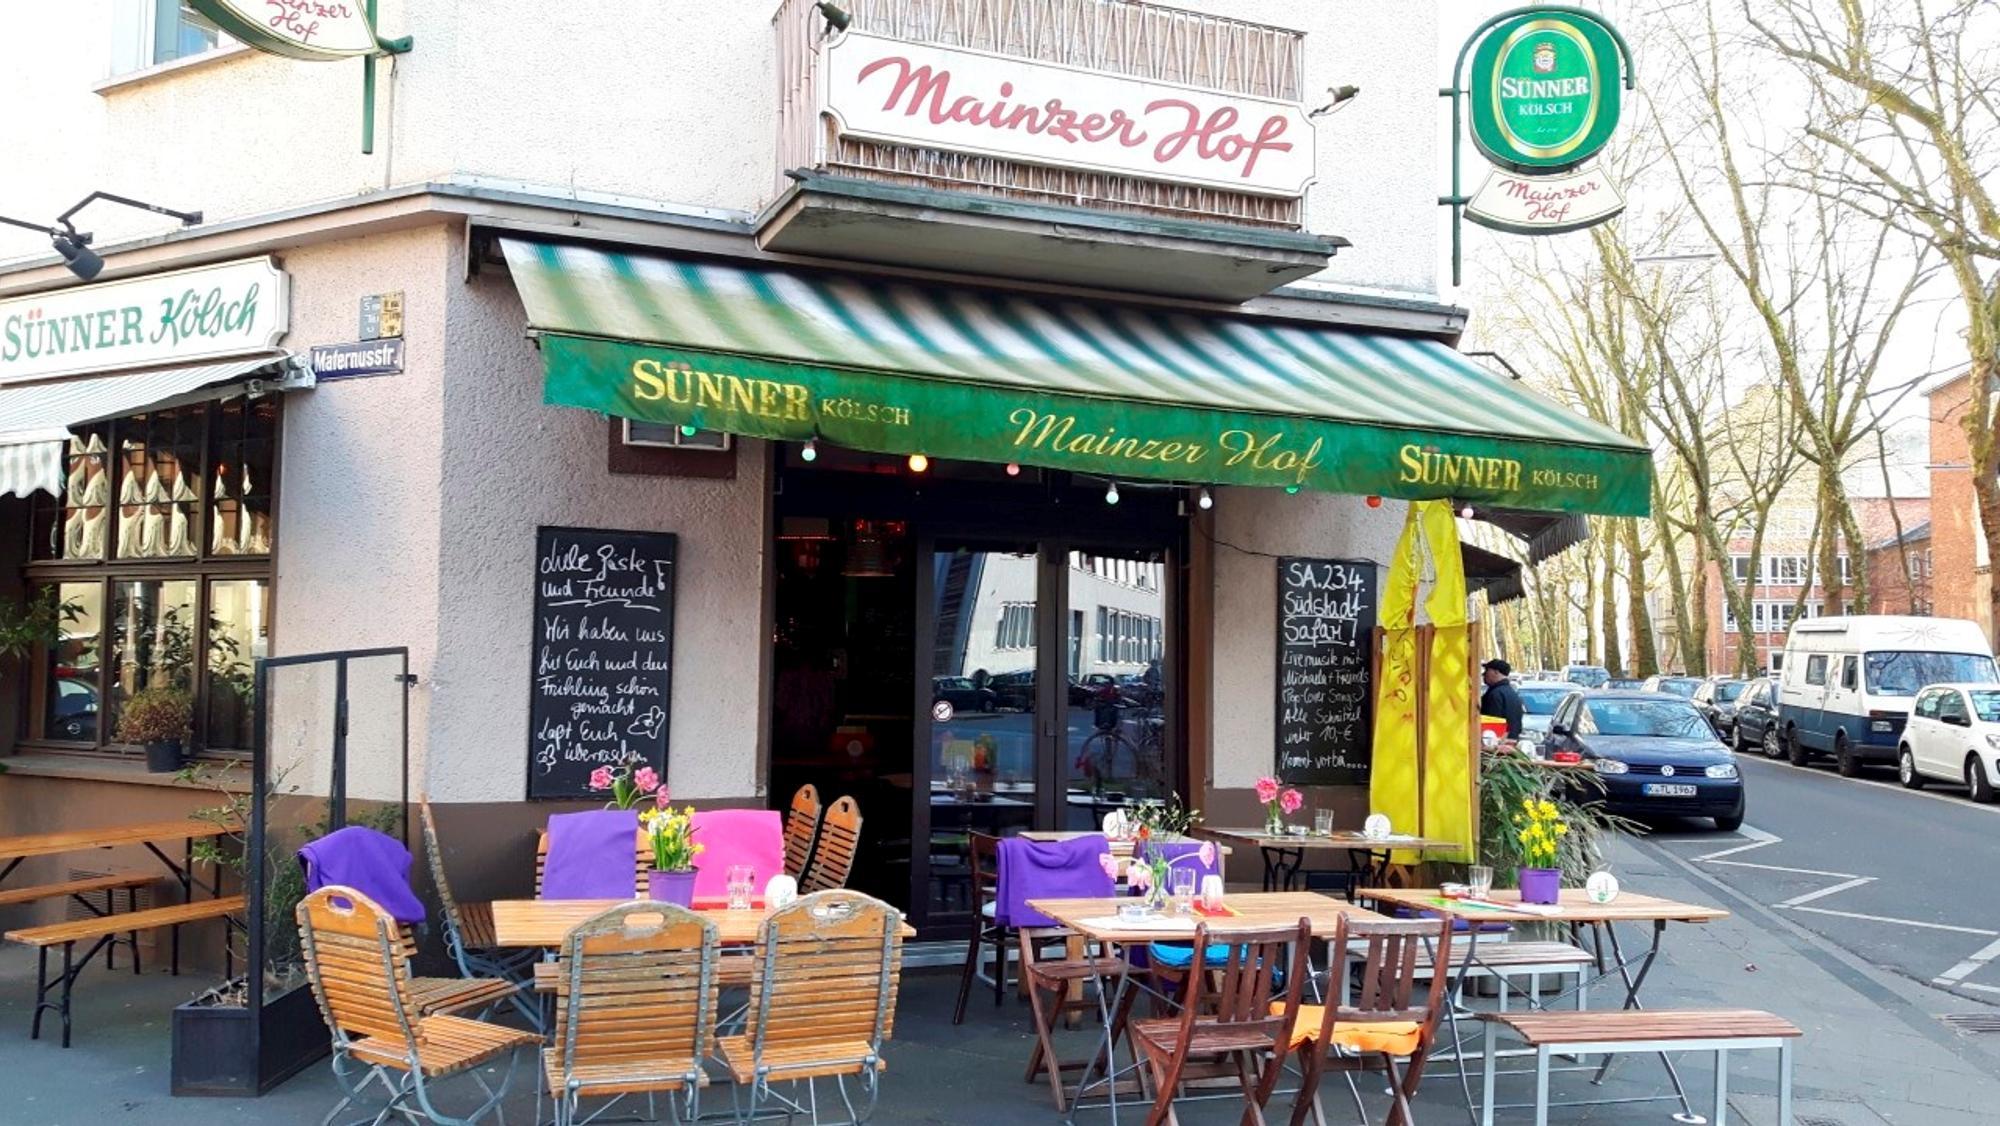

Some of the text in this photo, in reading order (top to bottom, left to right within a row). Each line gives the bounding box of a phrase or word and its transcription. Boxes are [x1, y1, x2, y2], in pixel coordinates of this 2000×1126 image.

[267, 2, 319, 44] Hof
[1501, 76, 1590, 99] SÜNNER
[857, 56, 1294, 178] Mainzer Hof
[1497, 179, 1600, 200] Mainzer
[1524, 201, 1571, 222] Hof
[2, 282, 260, 362] SÜNNER Kölsch
[314, 343, 399, 373] Maternusstr.
[632, 358, 911, 426] SÜNNER KÖLSCH
[1009, 408, 1324, 484] Mainzer Hof
[1400, 444, 1599, 492] SÜNNER KÖLSCH
[542, 578, 573, 598] und
[543, 615, 666, 642] Wir haben uns
[565, 648, 600, 671] Euch
[604, 650, 638, 670] und
[641, 650, 668, 671] den
[1342, 649, 1363, 666] mit
[615, 676, 660, 696] schön
[570, 697, 635, 720] gemacht
[1283, 707, 1308, 725] Alle
[579, 720, 618, 741] Euch
